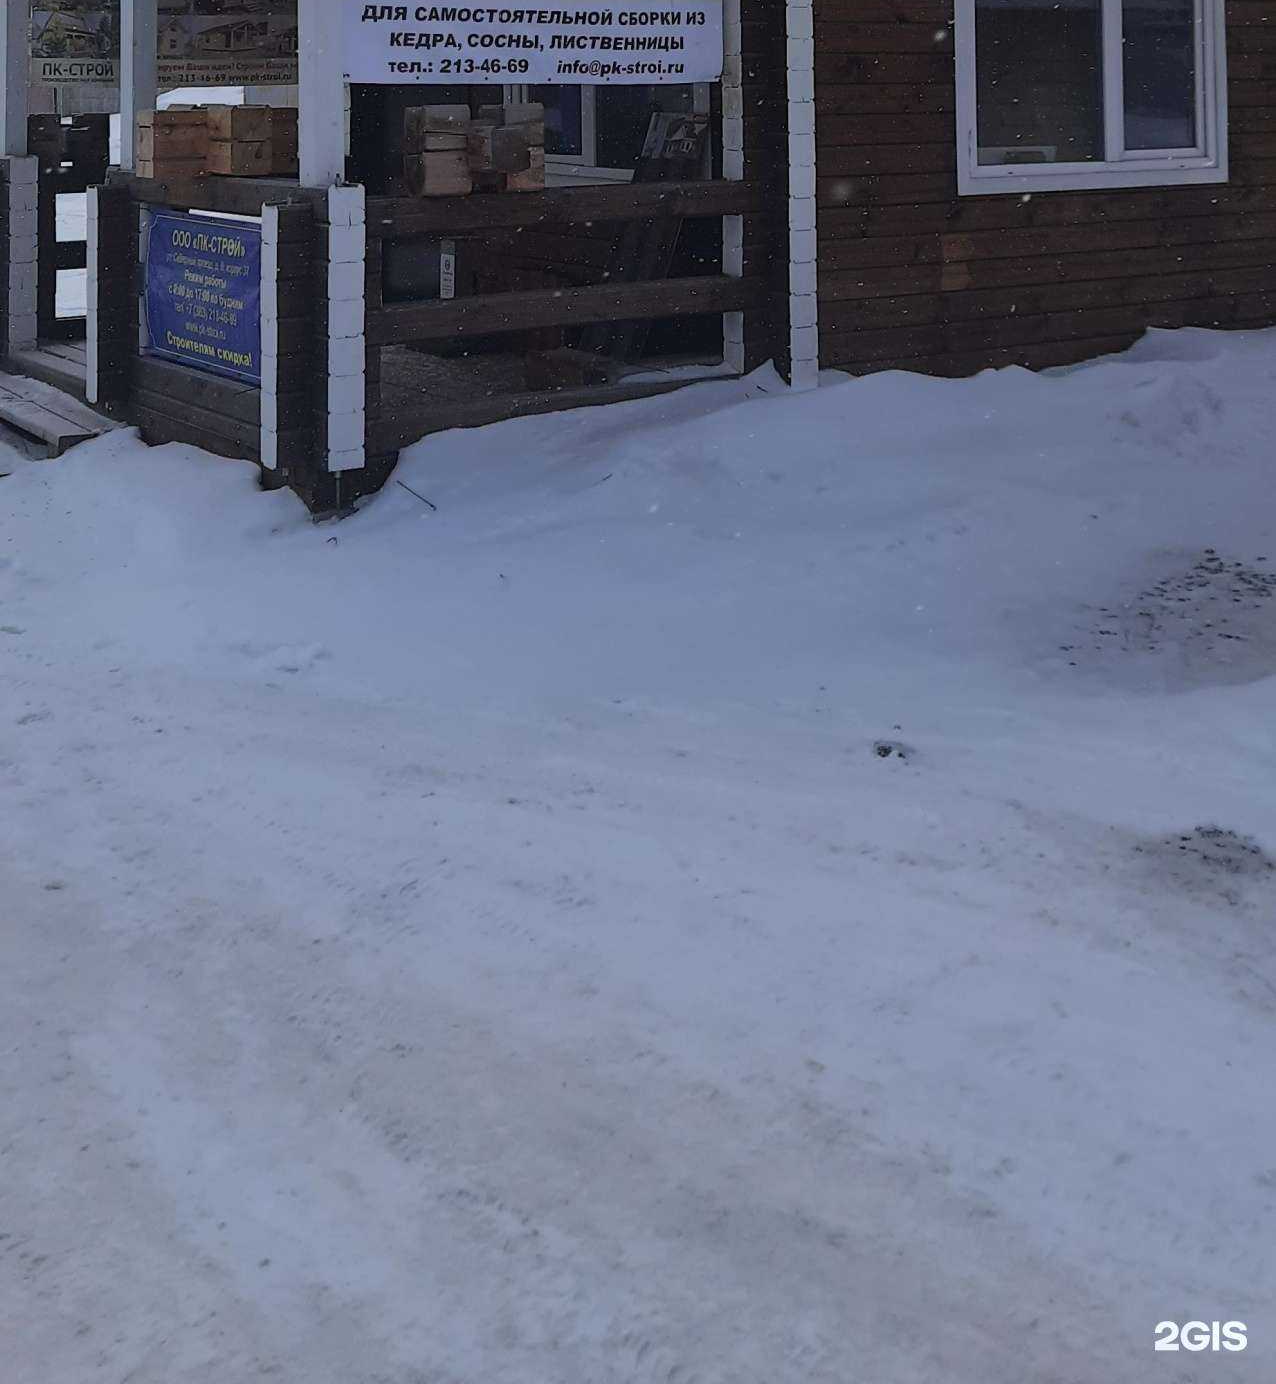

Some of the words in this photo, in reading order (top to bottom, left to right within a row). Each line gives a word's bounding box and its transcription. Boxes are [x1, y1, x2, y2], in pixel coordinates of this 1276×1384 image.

[362, 4, 407, 22] ДЛЯ
[414, 6, 613, 26] САМОСТОЯТЕЛЬНОЙ
[618, 11, 682, 26] СБОРКИ
[686, 12, 705, 26] ИЗ
[390, 32, 462, 50] КЕДРА,
[467, 33, 545, 51] СОСНЫ,
[549, 35, 685, 52] ЛИСТВЕННИЦЫ
[43, 62, 114, 76] ПК-СТРОЙ
[388, 60, 433, 74] тел.:
[439, 58, 529, 74] 213-46-69
[556, 59, 685, 76] info@pk-stroi.ru
[172, 230, 191, 249] ООО
[193, 231, 246, 257] «ПК-СТРОЙ»
